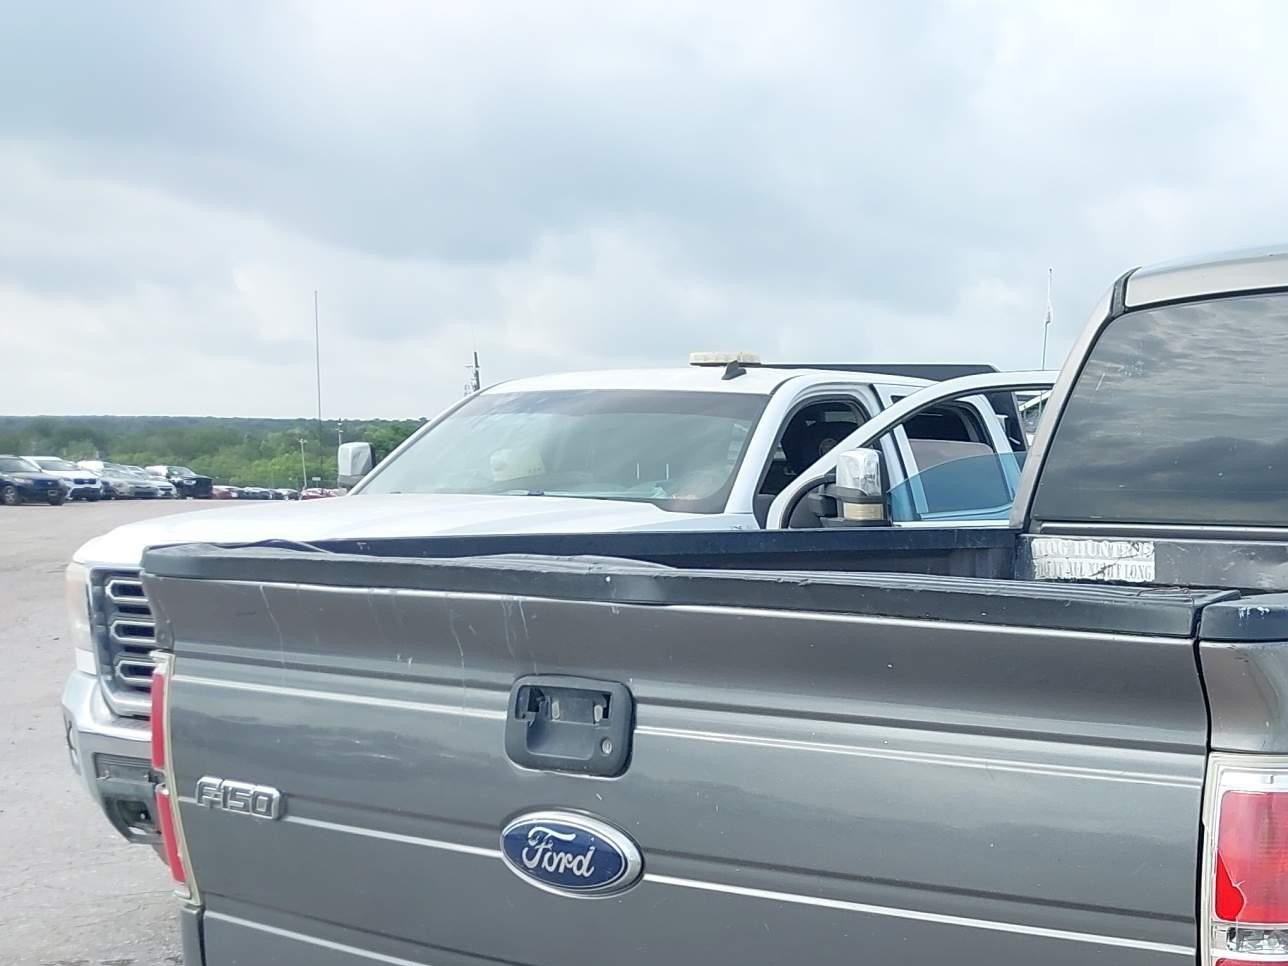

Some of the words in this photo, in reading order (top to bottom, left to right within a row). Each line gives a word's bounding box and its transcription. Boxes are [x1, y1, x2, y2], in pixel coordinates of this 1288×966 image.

[1087, 562, 1121, 580] NIHT
[1123, 563, 1152, 582] LONG
[522, 826, 595, 877] Ford
